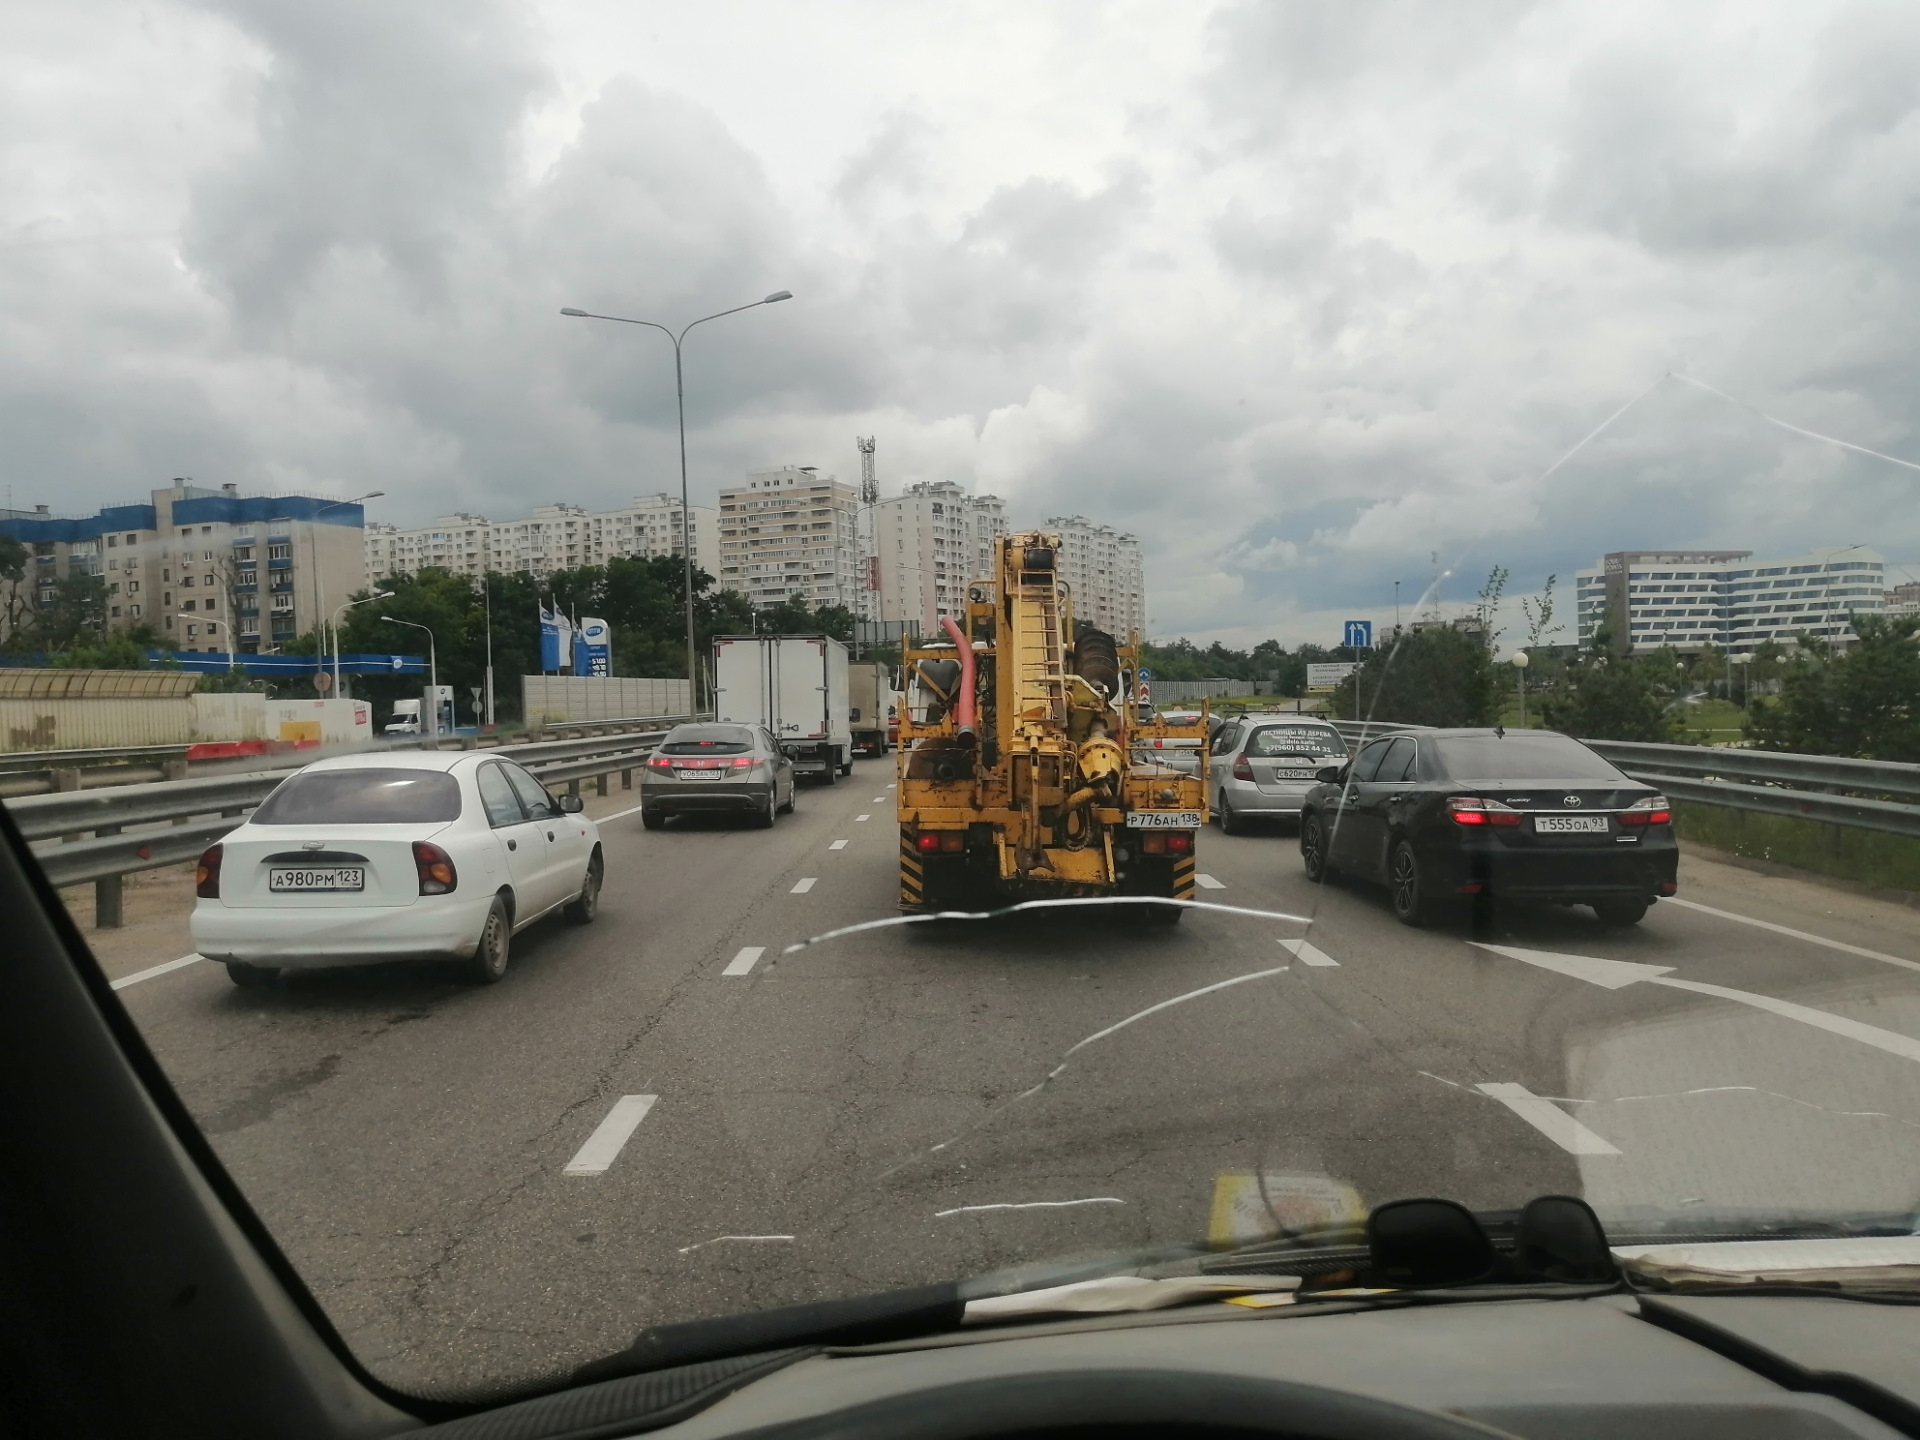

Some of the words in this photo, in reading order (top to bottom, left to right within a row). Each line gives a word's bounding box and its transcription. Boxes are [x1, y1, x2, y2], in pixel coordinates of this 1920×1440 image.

[1130, 814, 1178, 826] Р776АН
[1180, 813, 1198, 823] 138
[1540, 818, 1589, 831] Т555ОА
[1591, 818, 1604, 828] 93
[275, 871, 335, 886] А980РМ
[337, 870, 359, 882] 123
